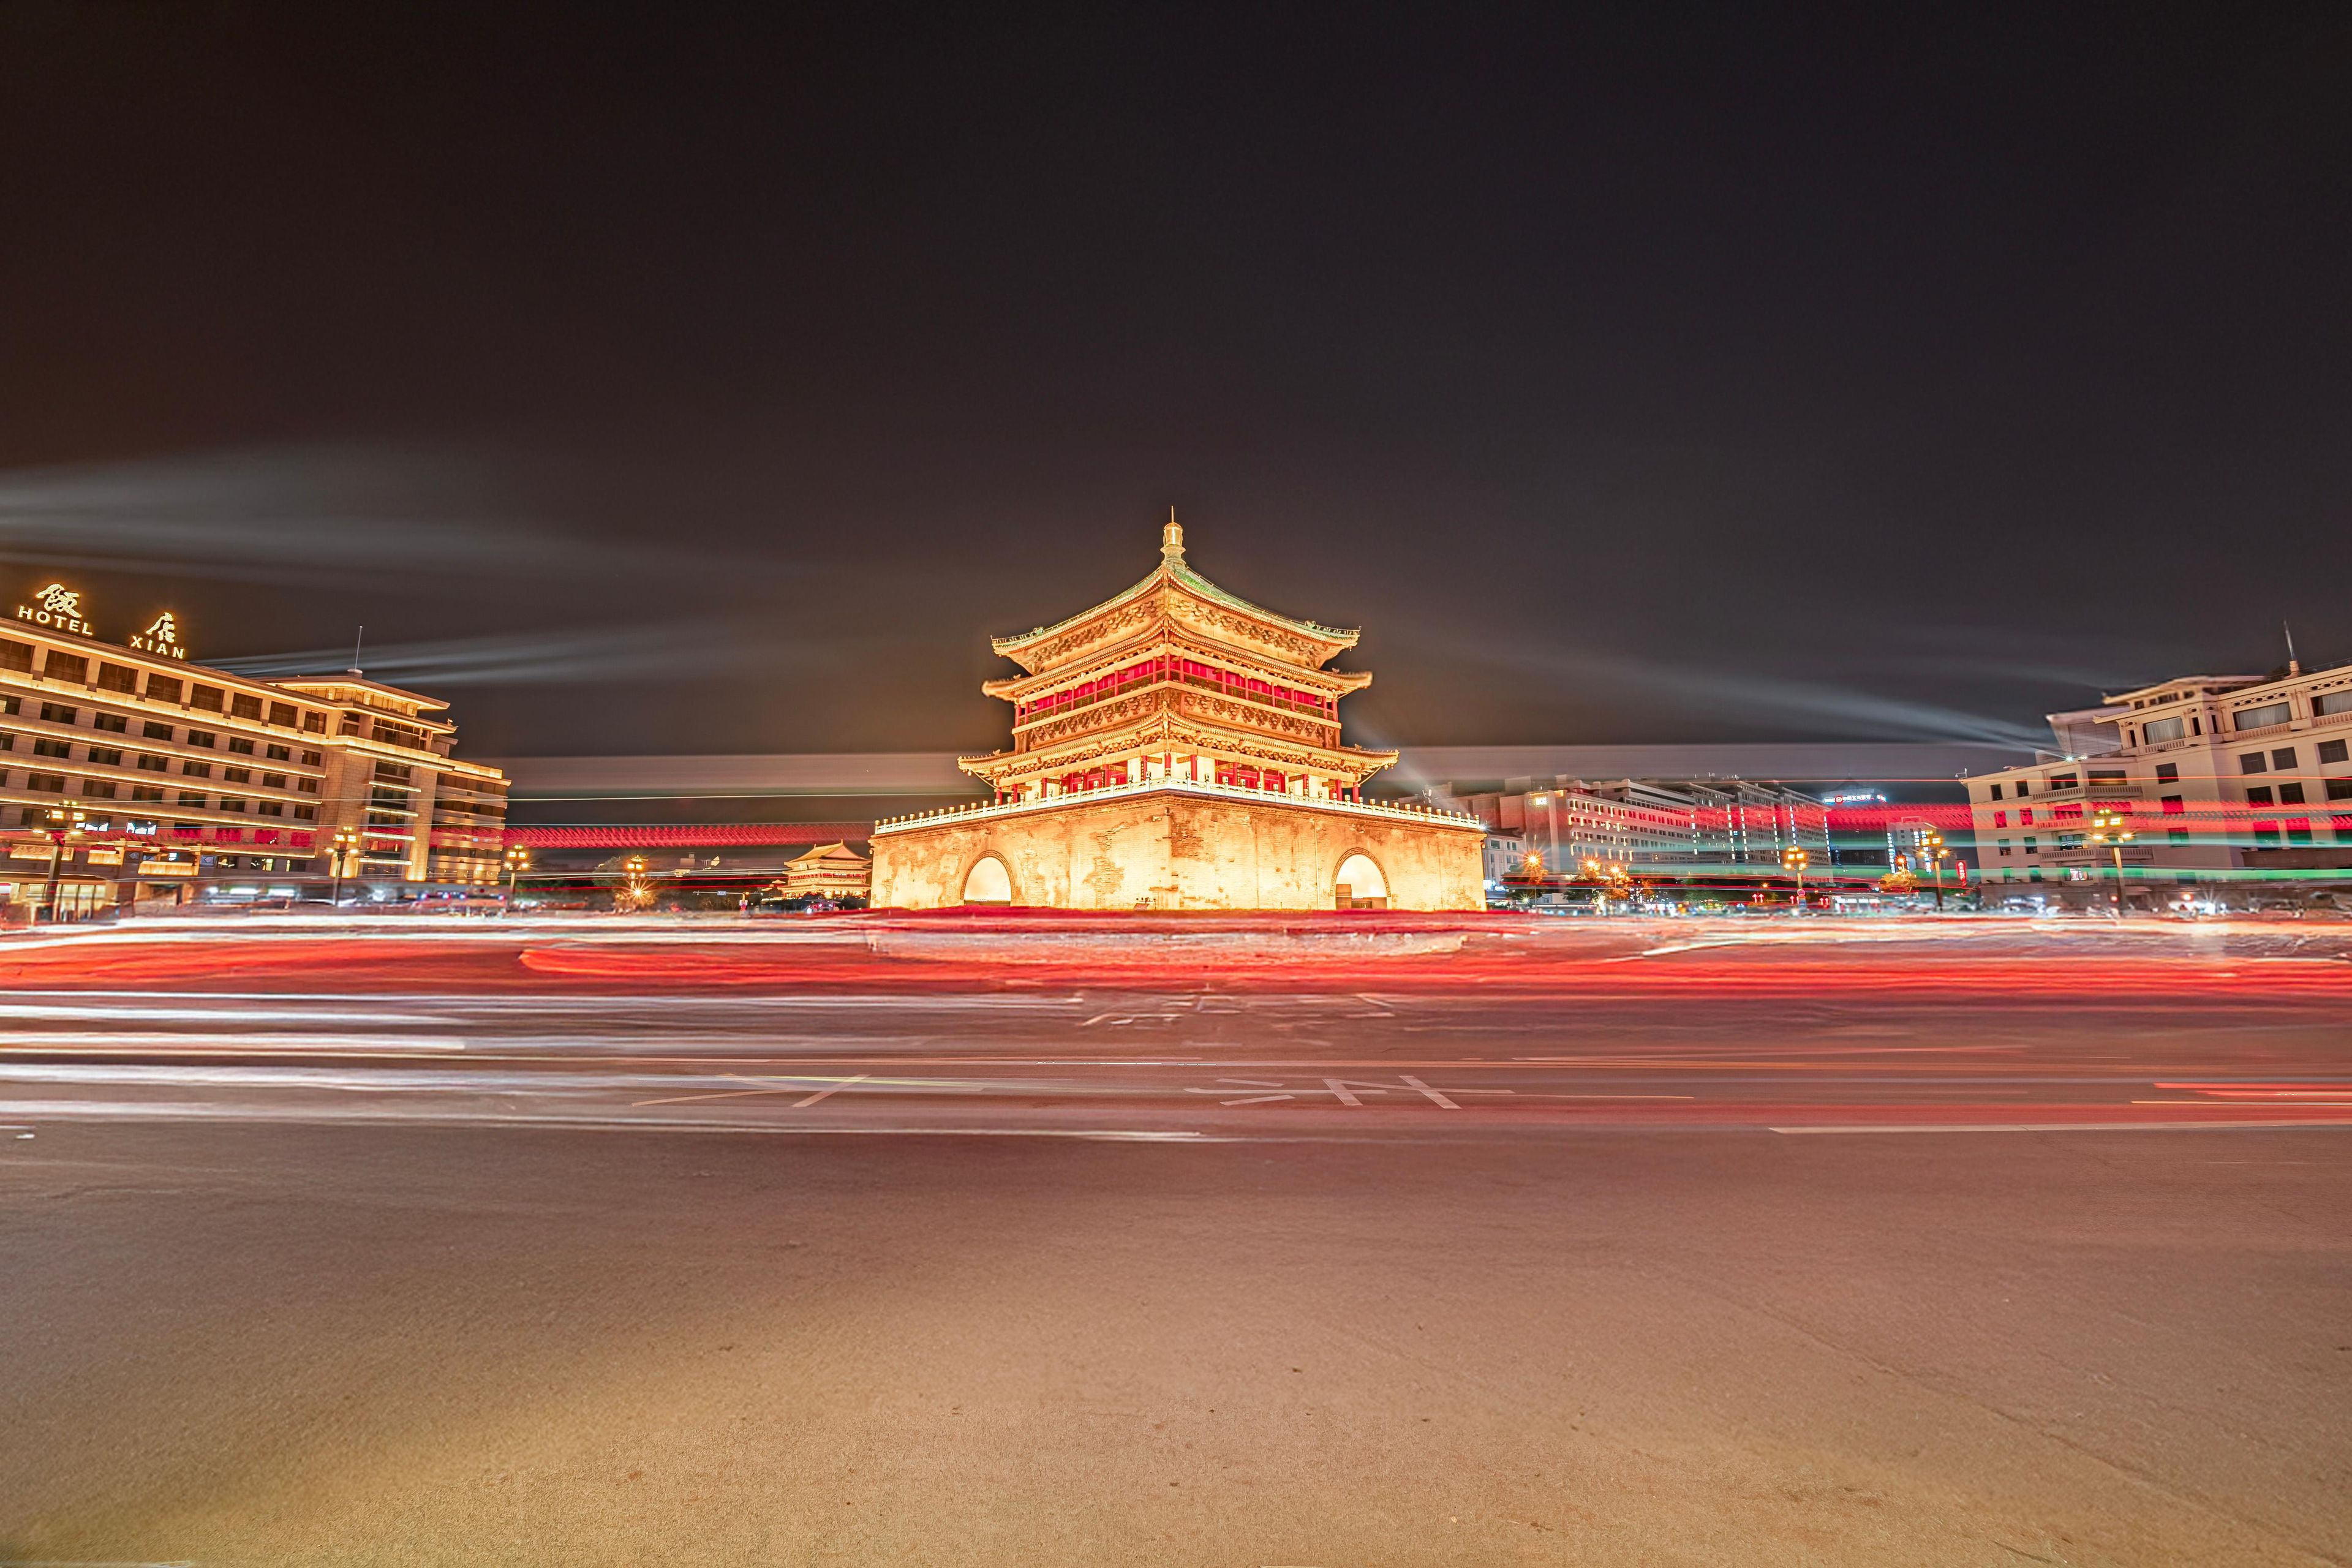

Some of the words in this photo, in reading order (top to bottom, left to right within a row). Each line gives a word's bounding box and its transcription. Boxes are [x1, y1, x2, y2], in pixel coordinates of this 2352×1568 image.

[18, 606, 93, 636] HOTEL
[130, 635, 184, 659] XIAN
[146, 612, 176, 643] 店
